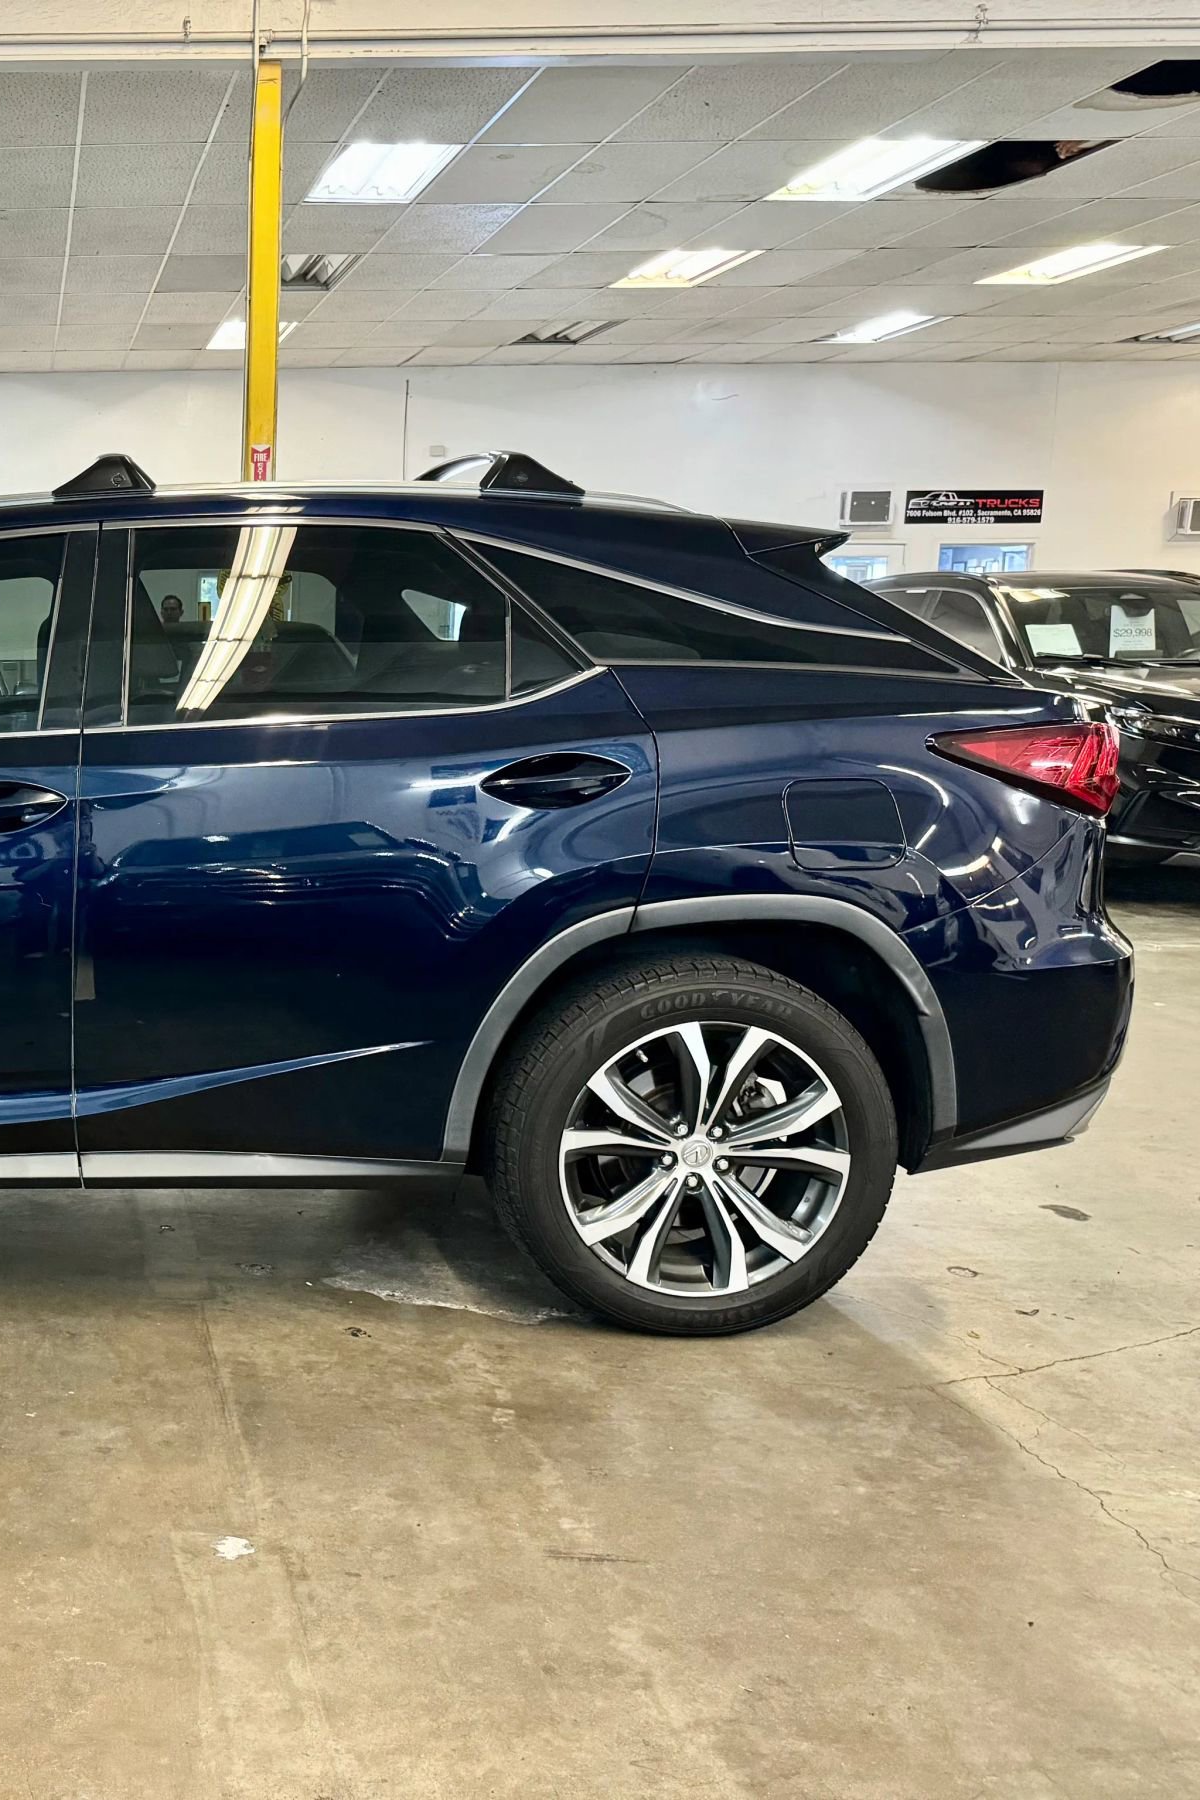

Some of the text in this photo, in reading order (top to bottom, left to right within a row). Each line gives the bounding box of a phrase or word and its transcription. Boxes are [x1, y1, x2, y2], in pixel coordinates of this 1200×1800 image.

[253, 453, 268, 462] FIRE
[975, 499, 1041, 508] TRUCKS
[922, 509, 943, 517] Folsom
[1113, 627, 1153, 638] $29,998
